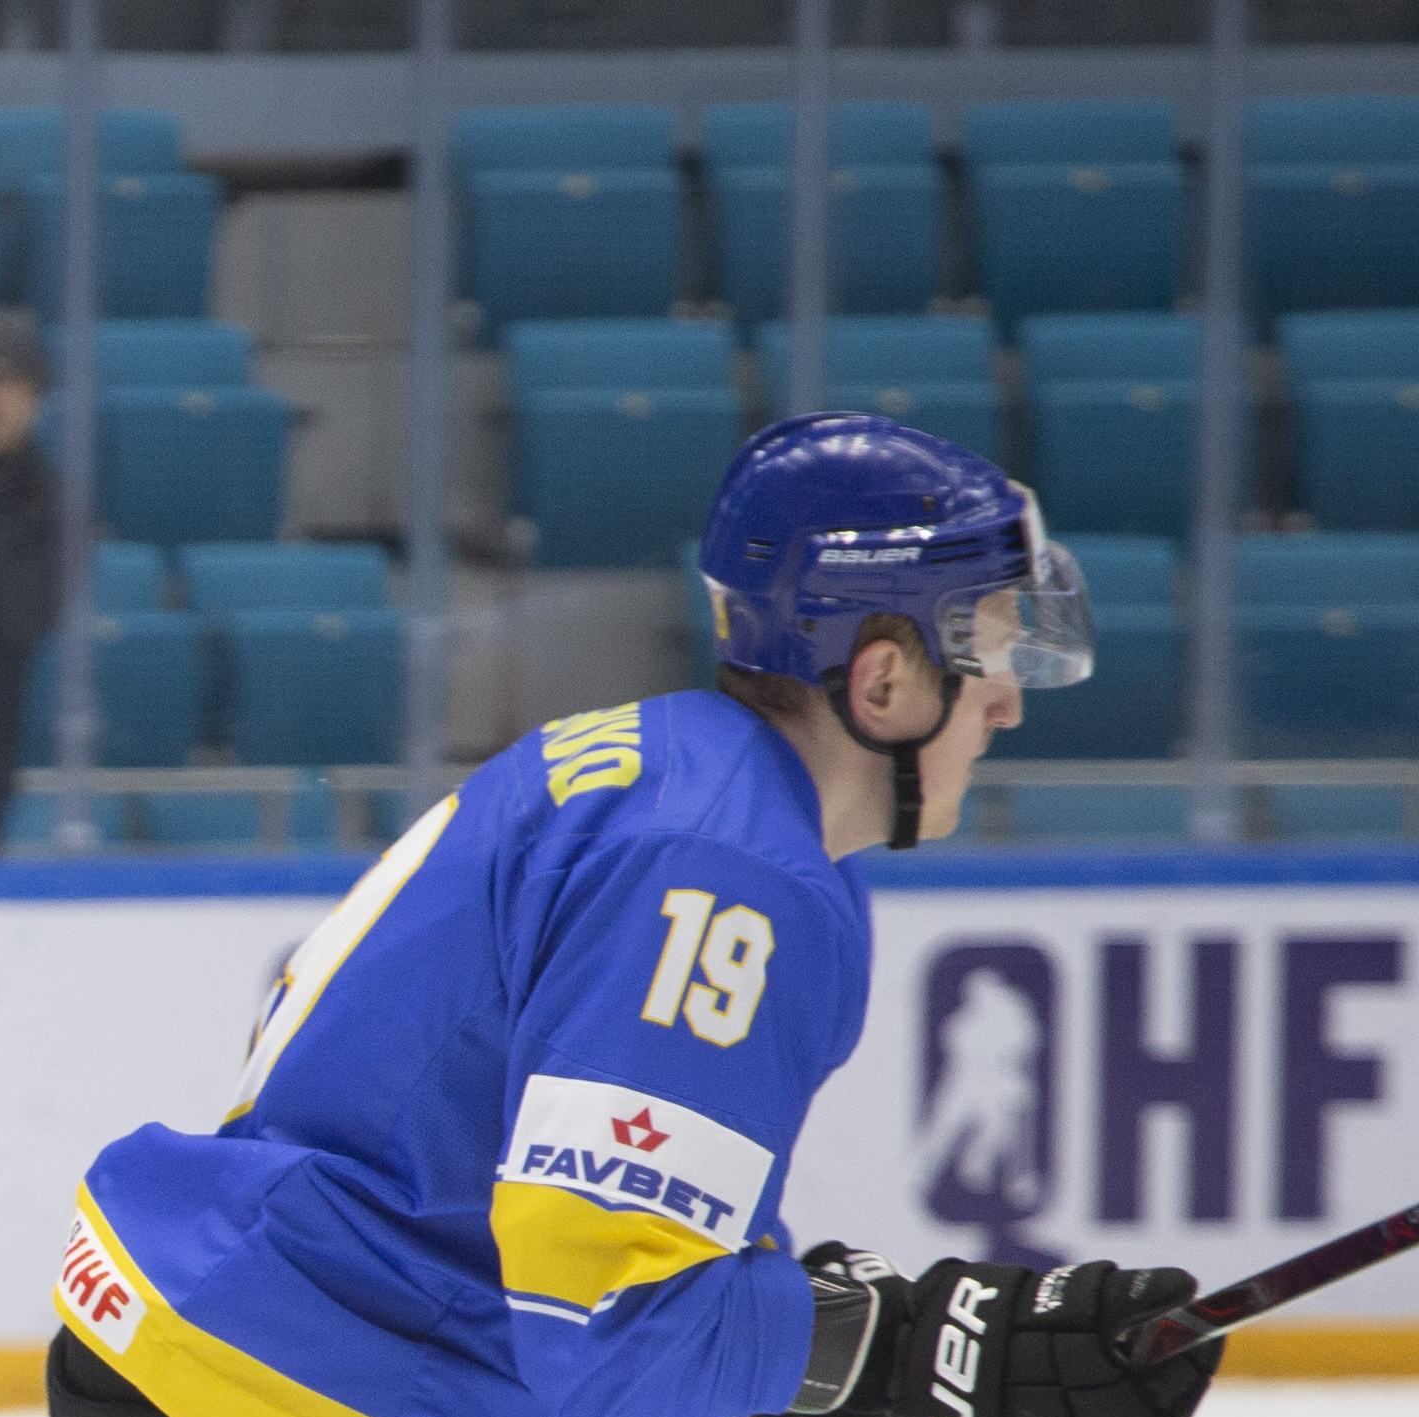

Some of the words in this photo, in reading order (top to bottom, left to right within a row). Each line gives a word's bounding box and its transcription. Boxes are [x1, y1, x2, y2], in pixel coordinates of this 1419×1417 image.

[818, 545, 923, 565] BAUER
[641, 887, 775, 1048] 19
[521, 1142, 736, 1234] FAVBET
[62, 1235, 131, 1323] IIHF
